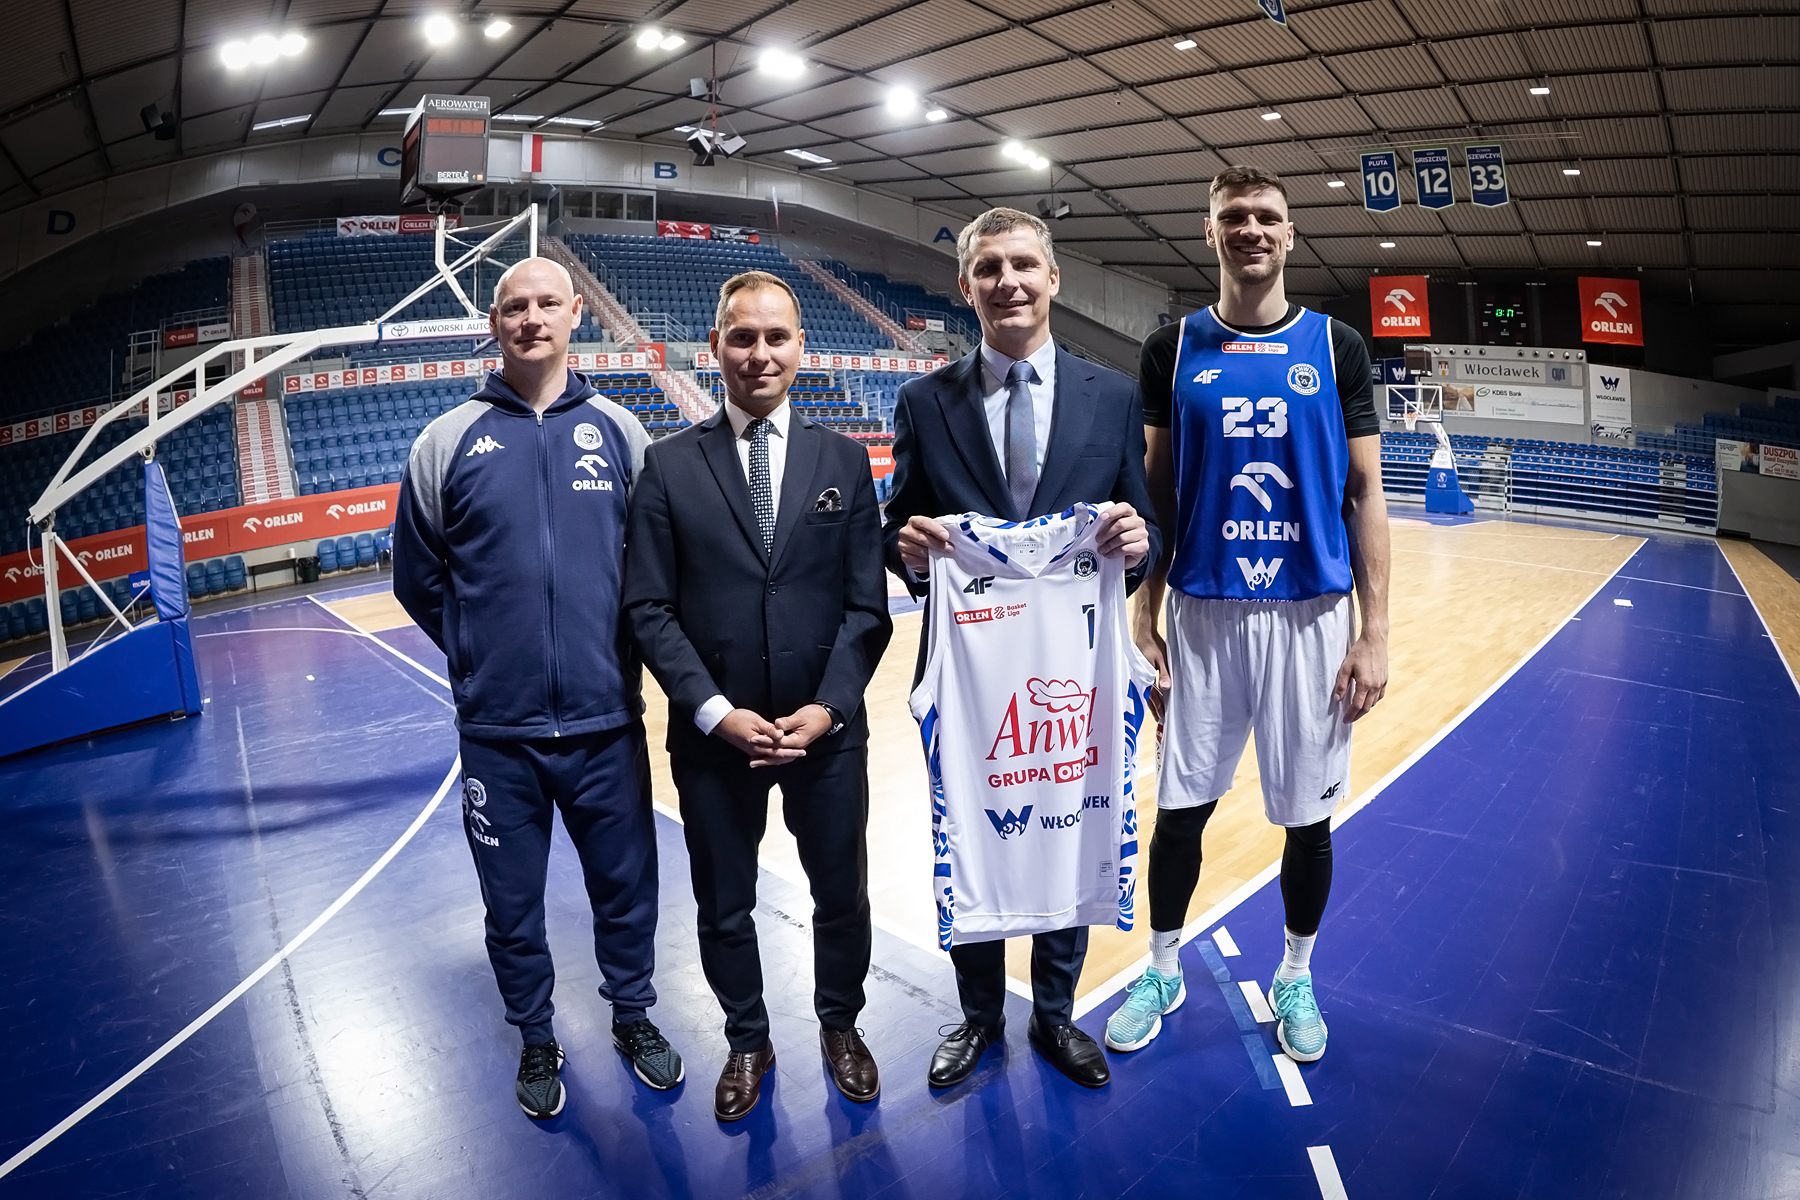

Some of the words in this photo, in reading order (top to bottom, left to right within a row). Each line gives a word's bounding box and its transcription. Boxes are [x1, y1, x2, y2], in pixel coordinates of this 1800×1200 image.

[427, 99, 487, 109] AEROWATCH
[377, 147, 403, 167] C
[654, 162, 678, 179] B
[1470, 164, 1505, 191] 33
[1365, 171, 1395, 197] 10
[1419, 167, 1449, 194] 12
[47, 210, 76, 235] D
[360, 221, 397, 230] ORLEN
[933, 227, 957, 243] A
[418, 324, 463, 333] JAWORSKI
[1381, 316, 1421, 327] ORLEN
[1591, 321, 1633, 334] ORLEN
[1464, 363, 1540, 378] Włocławek
[1222, 397, 1288, 438] 23
[1763, 446, 1799, 460] DUSZPOL
[572, 479, 613, 492] ORLEN
[347, 500, 386, 516] ORLEN
[263, 512, 303, 528] ORLEN
[182, 528, 214, 544] RLEN
[1221, 519, 1300, 542] ORLEN
[95, 544, 133, 561] ORLEN
[1006, 603, 1027, 611] Basket
[956, 611, 990, 623] ORLEN
[1082, 603, 1095, 650] 1
[988, 767, 1051, 788] GRUPA
[1039, 795, 1110, 830] WŁOCWEK
